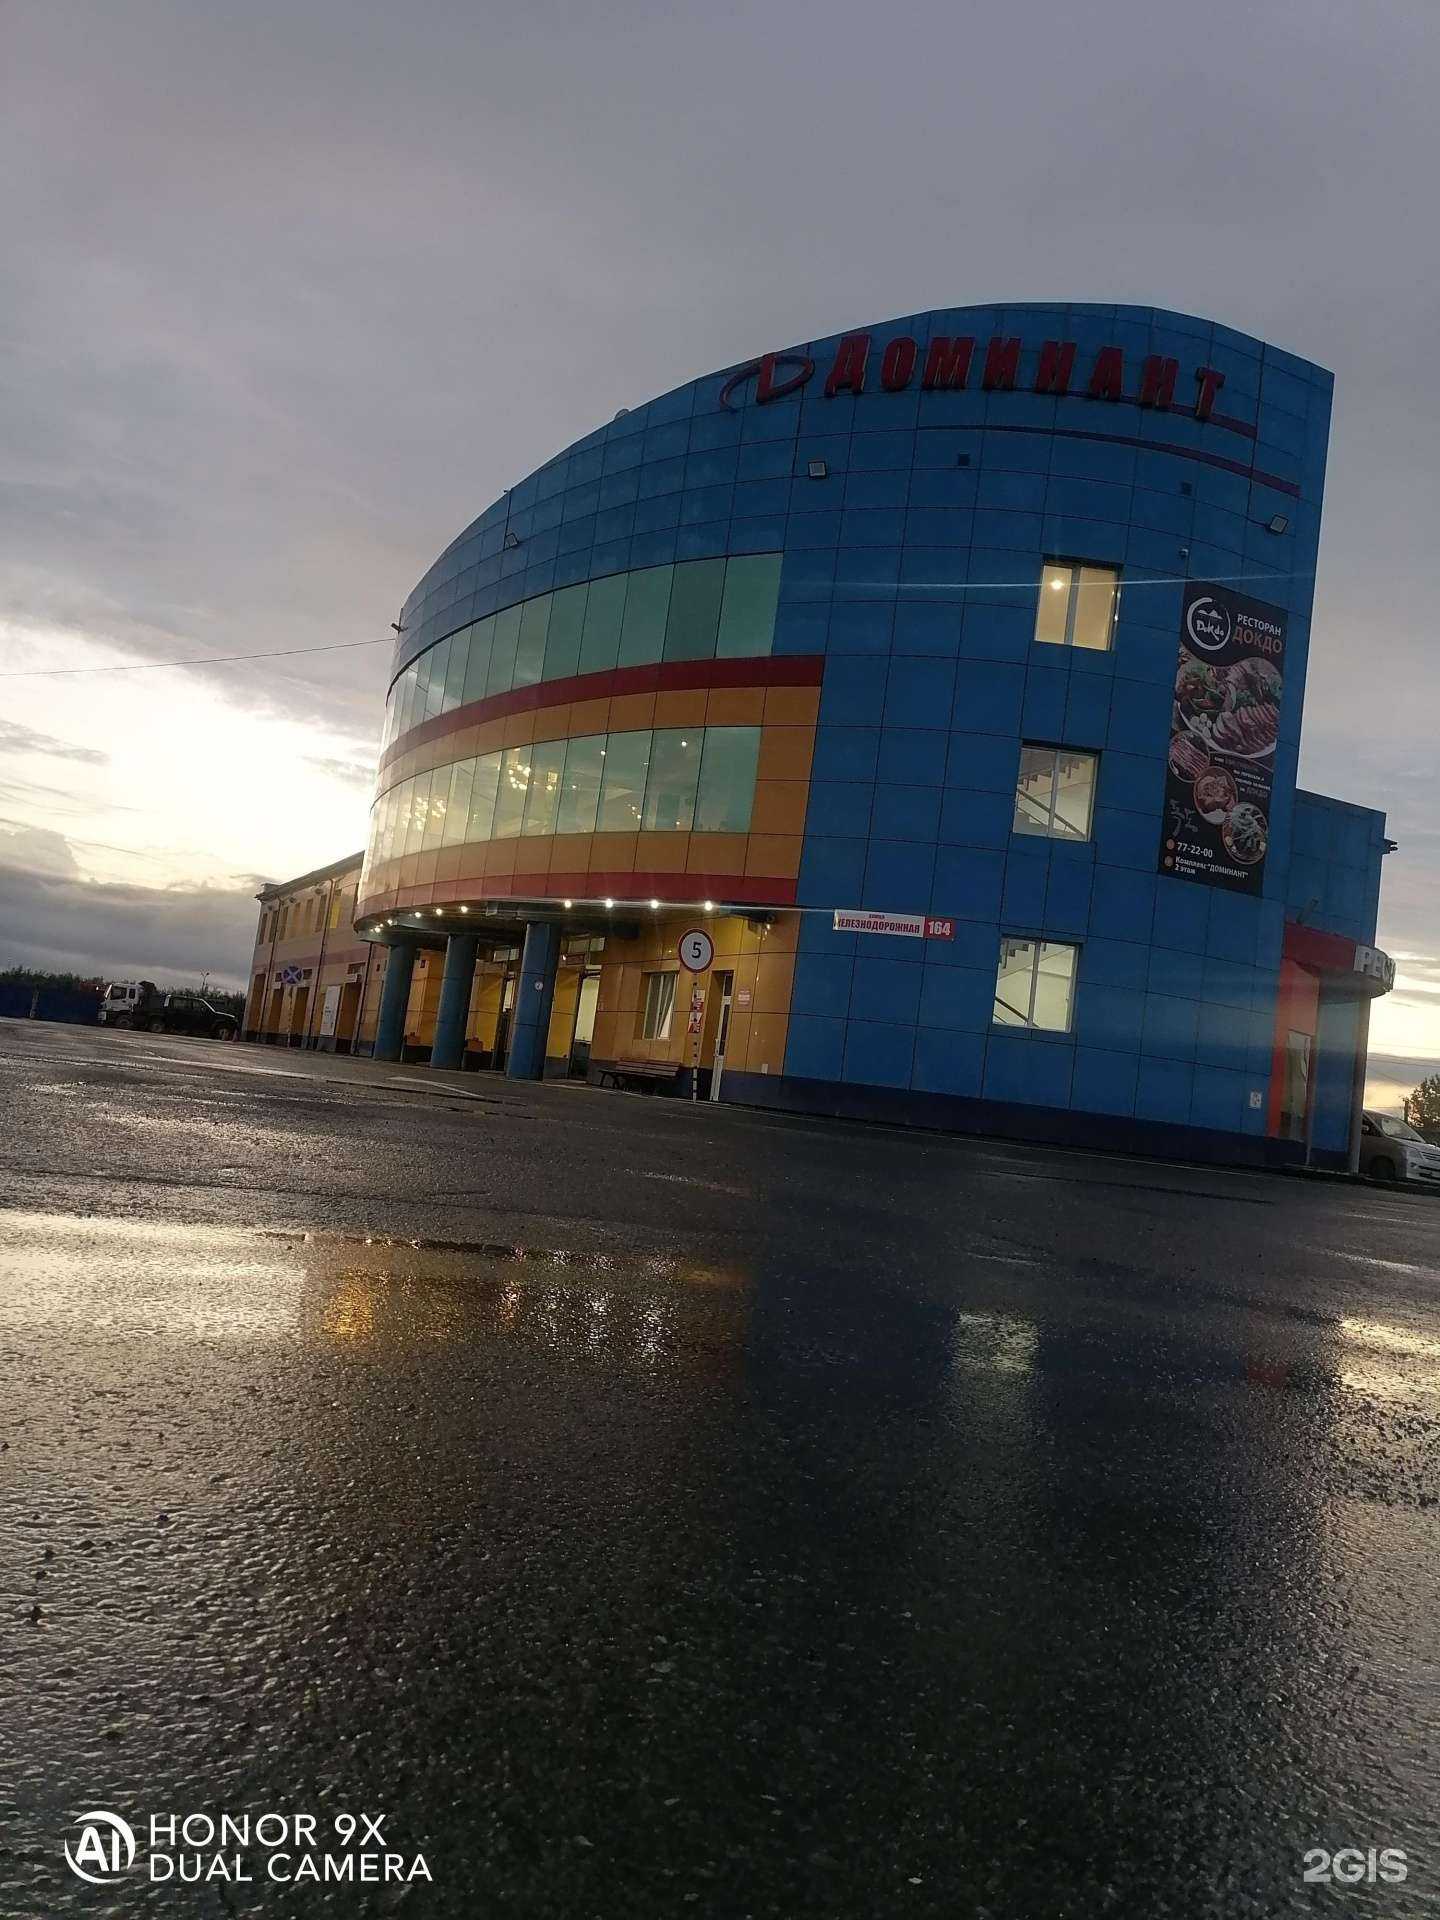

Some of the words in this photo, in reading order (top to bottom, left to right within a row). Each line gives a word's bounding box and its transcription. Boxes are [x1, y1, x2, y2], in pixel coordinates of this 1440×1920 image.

[823, 334, 1226, 420] ДОМИНАНТ
[1237, 613, 1282, 637] РЕСТОРАН
[1232, 625, 1283, 655] ДОКДО
[1176, 841, 1213, 858] 77-22-00
[927, 920, 952, 936] 164
[691, 941, 702, 959] 5
